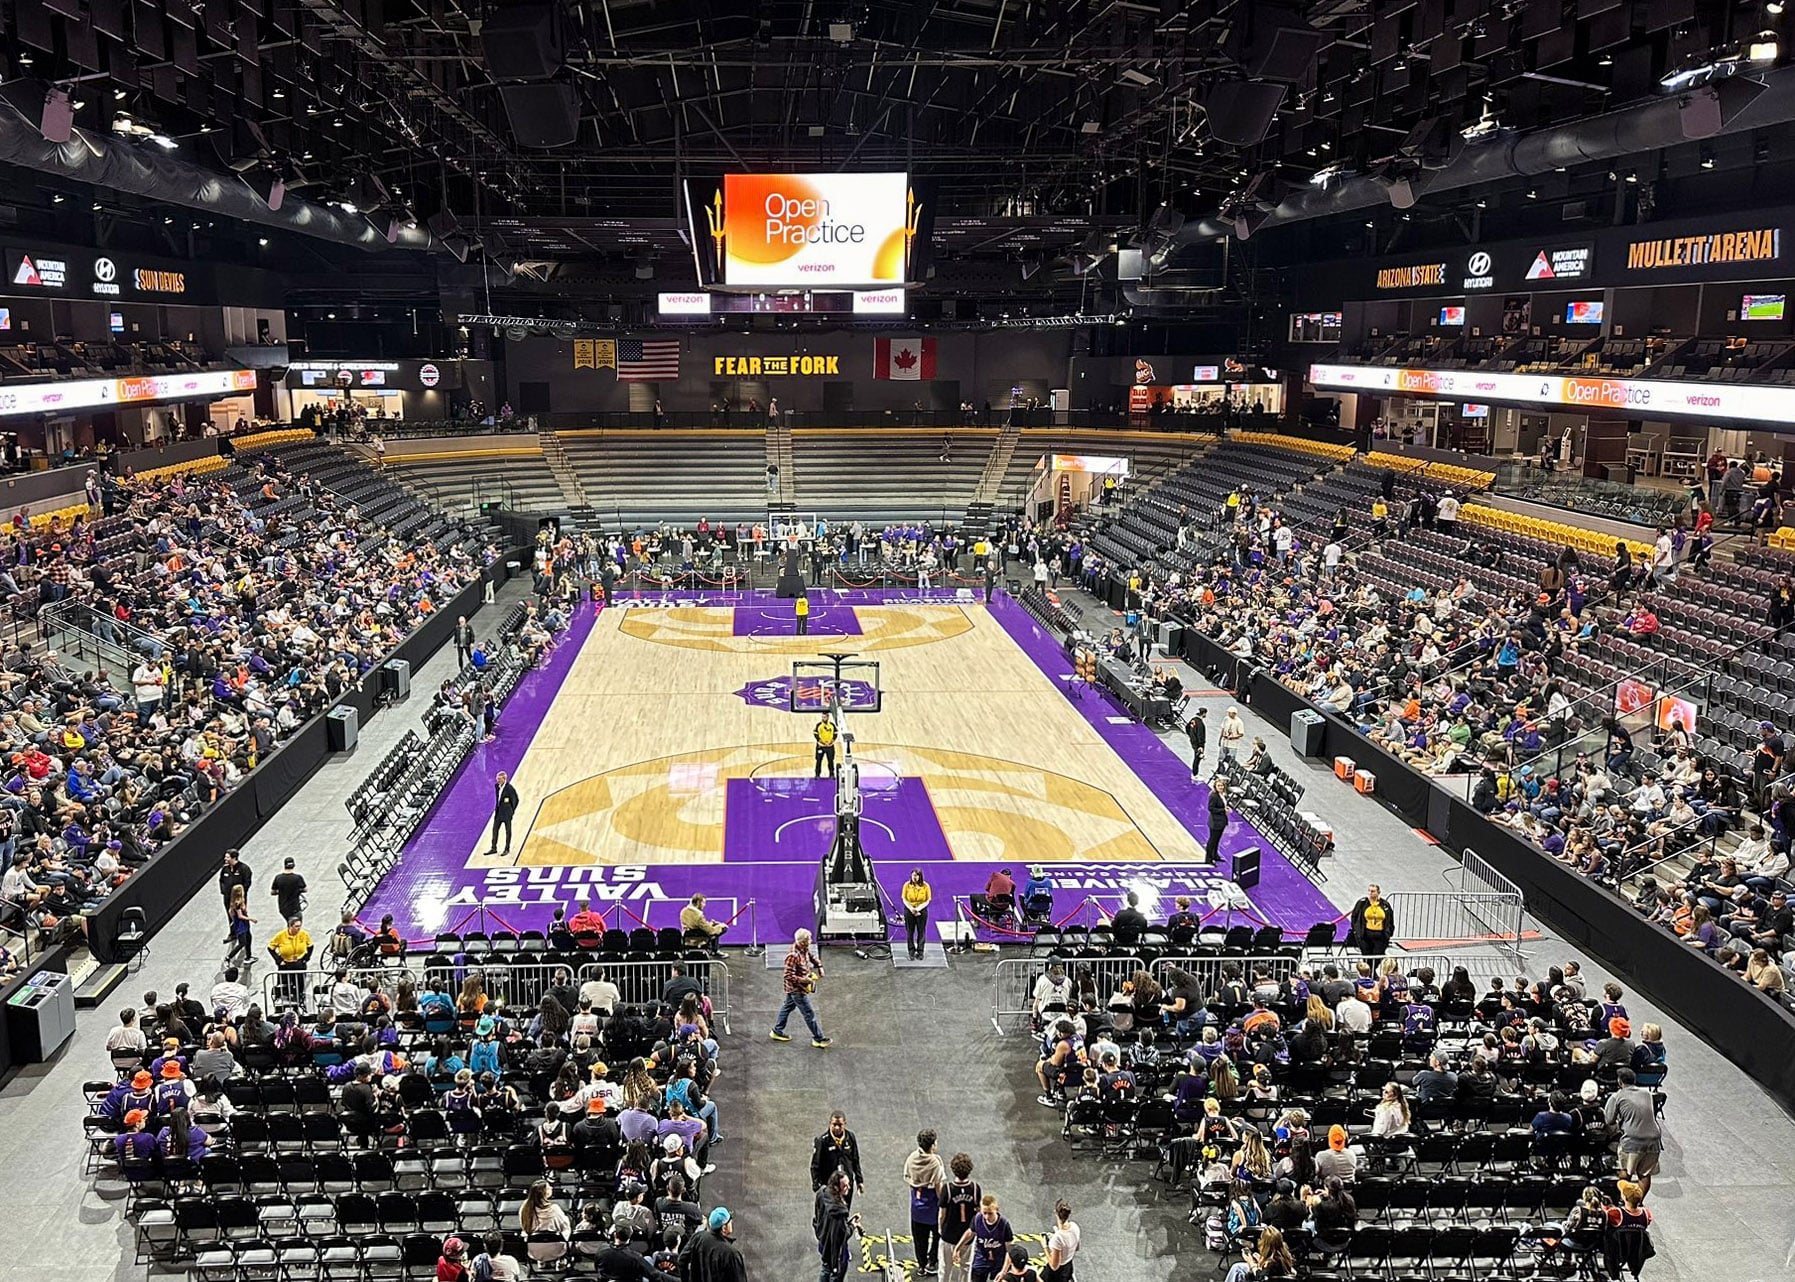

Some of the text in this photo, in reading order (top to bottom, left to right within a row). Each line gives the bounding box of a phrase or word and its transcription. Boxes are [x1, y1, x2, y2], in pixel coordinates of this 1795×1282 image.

[765, 193, 830, 223] Open
[766, 219, 865, 244] Practice
[1552, 249, 1588, 261] MOUNTAIN
[1627, 229, 1774, 269] MULLETT ARENA
[798, 263, 835, 272] verizon
[1553, 260, 1585, 271] AMERICA
[139, 269, 186, 294] SUN DEVILS
[1377, 264, 1442, 288] ARIZONA STATE
[666, 295, 703, 304] verizon
[861, 294, 898, 303] verizon
[715, 356, 839, 375] FEAR THE FORK
[120, 380, 142, 399] Open
[1402, 372, 1454, 390] Open Practice
[1567, 381, 1650, 405] Open Practice
[1687, 394, 1720, 407] verizon
[843, 838, 853, 873] NBA
[483, 866, 648, 884] SUNS
[448, 882, 670, 903] VALLEY
[590, 1089, 613, 1099] USA
[960, 1203, 966, 1222] 1
